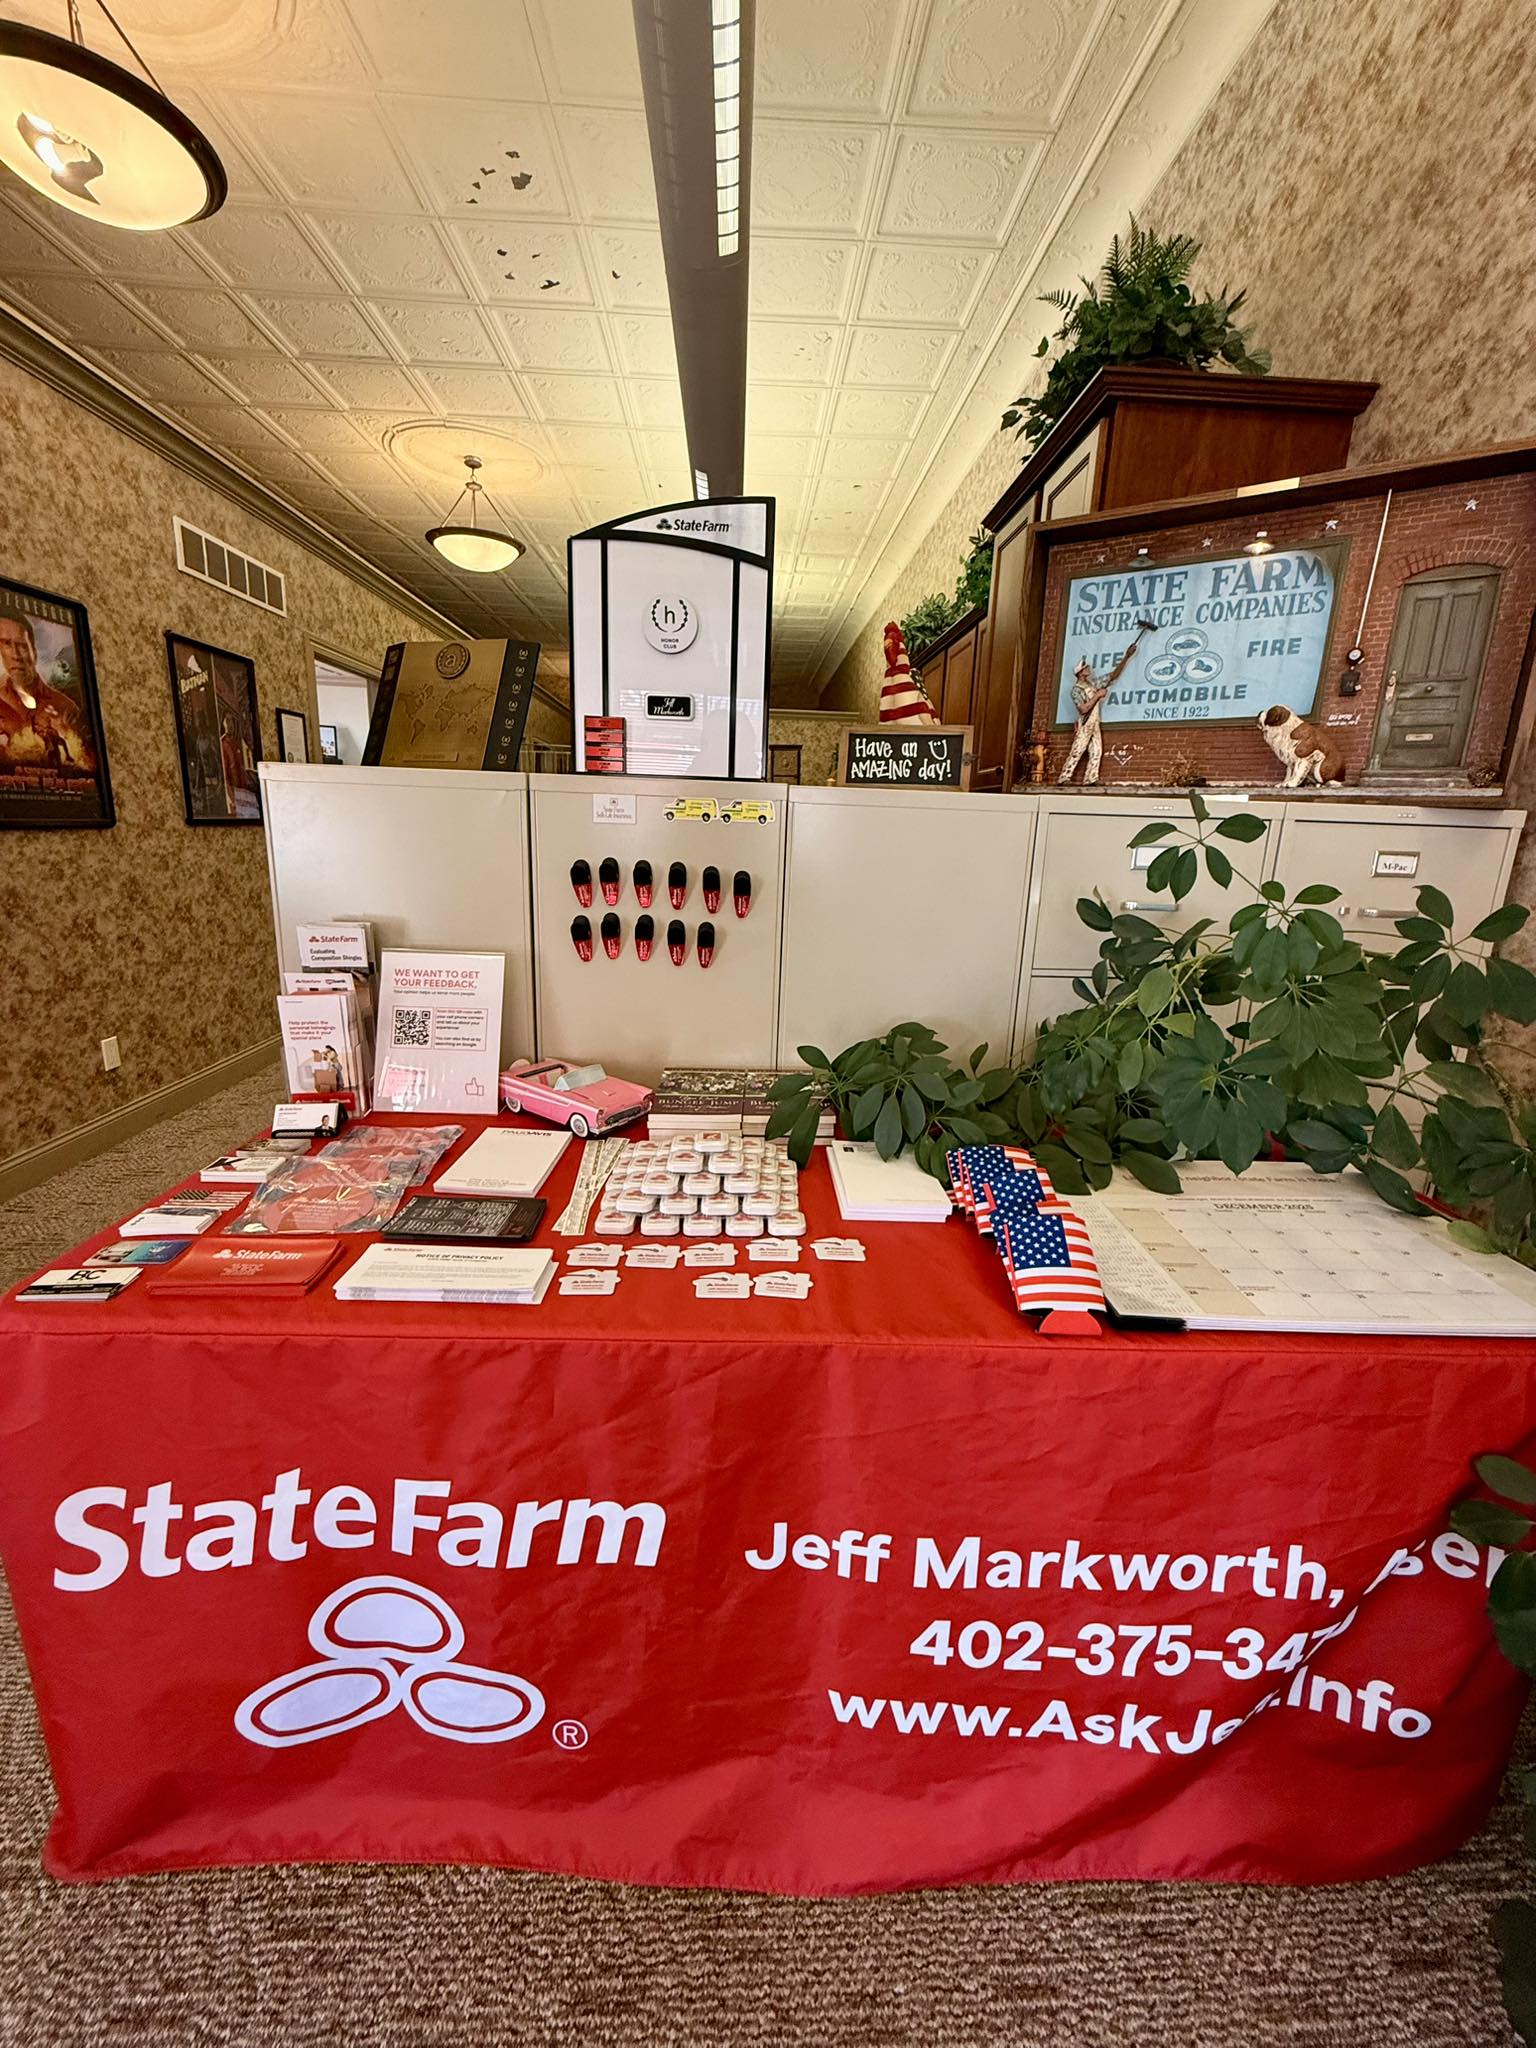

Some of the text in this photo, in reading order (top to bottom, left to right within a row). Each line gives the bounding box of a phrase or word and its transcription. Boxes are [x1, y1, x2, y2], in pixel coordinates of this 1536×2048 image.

[1077, 555, 1327, 614] STATE FARM
[1195, 589, 1329, 625] COMPANIES
[1247, 637, 1302, 658] FIRE
[1107, 684, 1248, 706] AUTOMOBILE
[1143, 706, 1210, 719] SINCE 1922
[855, 738, 918, 758] Have an
[851, 758, 952, 781] AMAZING day!
[1382, 862, 1408, 871] M-Pac
[394, 969, 480, 979] WE WANT TO GET
[394, 978, 478, 989] YOUR FEEDBACK.
[744, 1521, 893, 1583] Jeff
[913, 1536, 1344, 1608] Markworth,
[909, 1605, 1358, 1680] 402-375-34
[827, 1665, 1432, 1755] www.AskJe.Info
